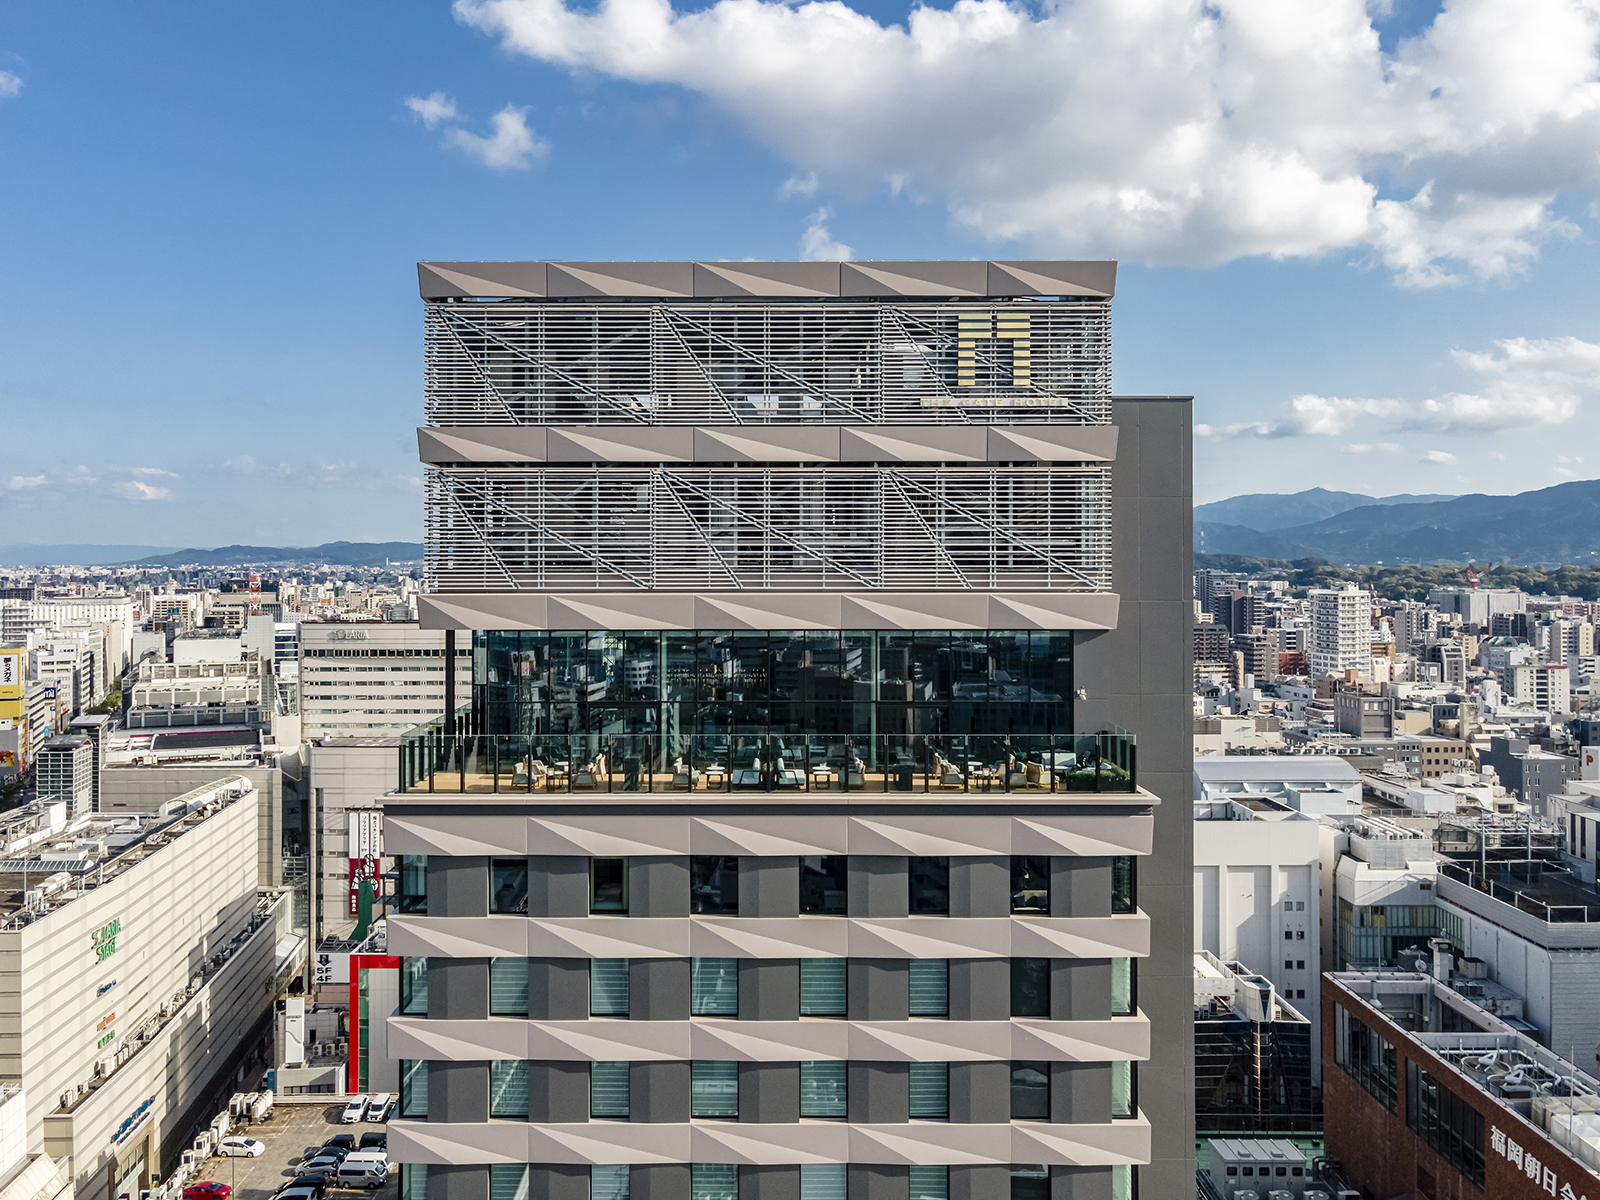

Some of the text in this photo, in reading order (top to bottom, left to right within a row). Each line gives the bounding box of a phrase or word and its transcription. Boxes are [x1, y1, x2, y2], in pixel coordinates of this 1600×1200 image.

[921, 398, 1069, 407] THE GATE HOTEL
[316, 967, 332, 975] 5F
[316, 975, 332, 983] 4F
